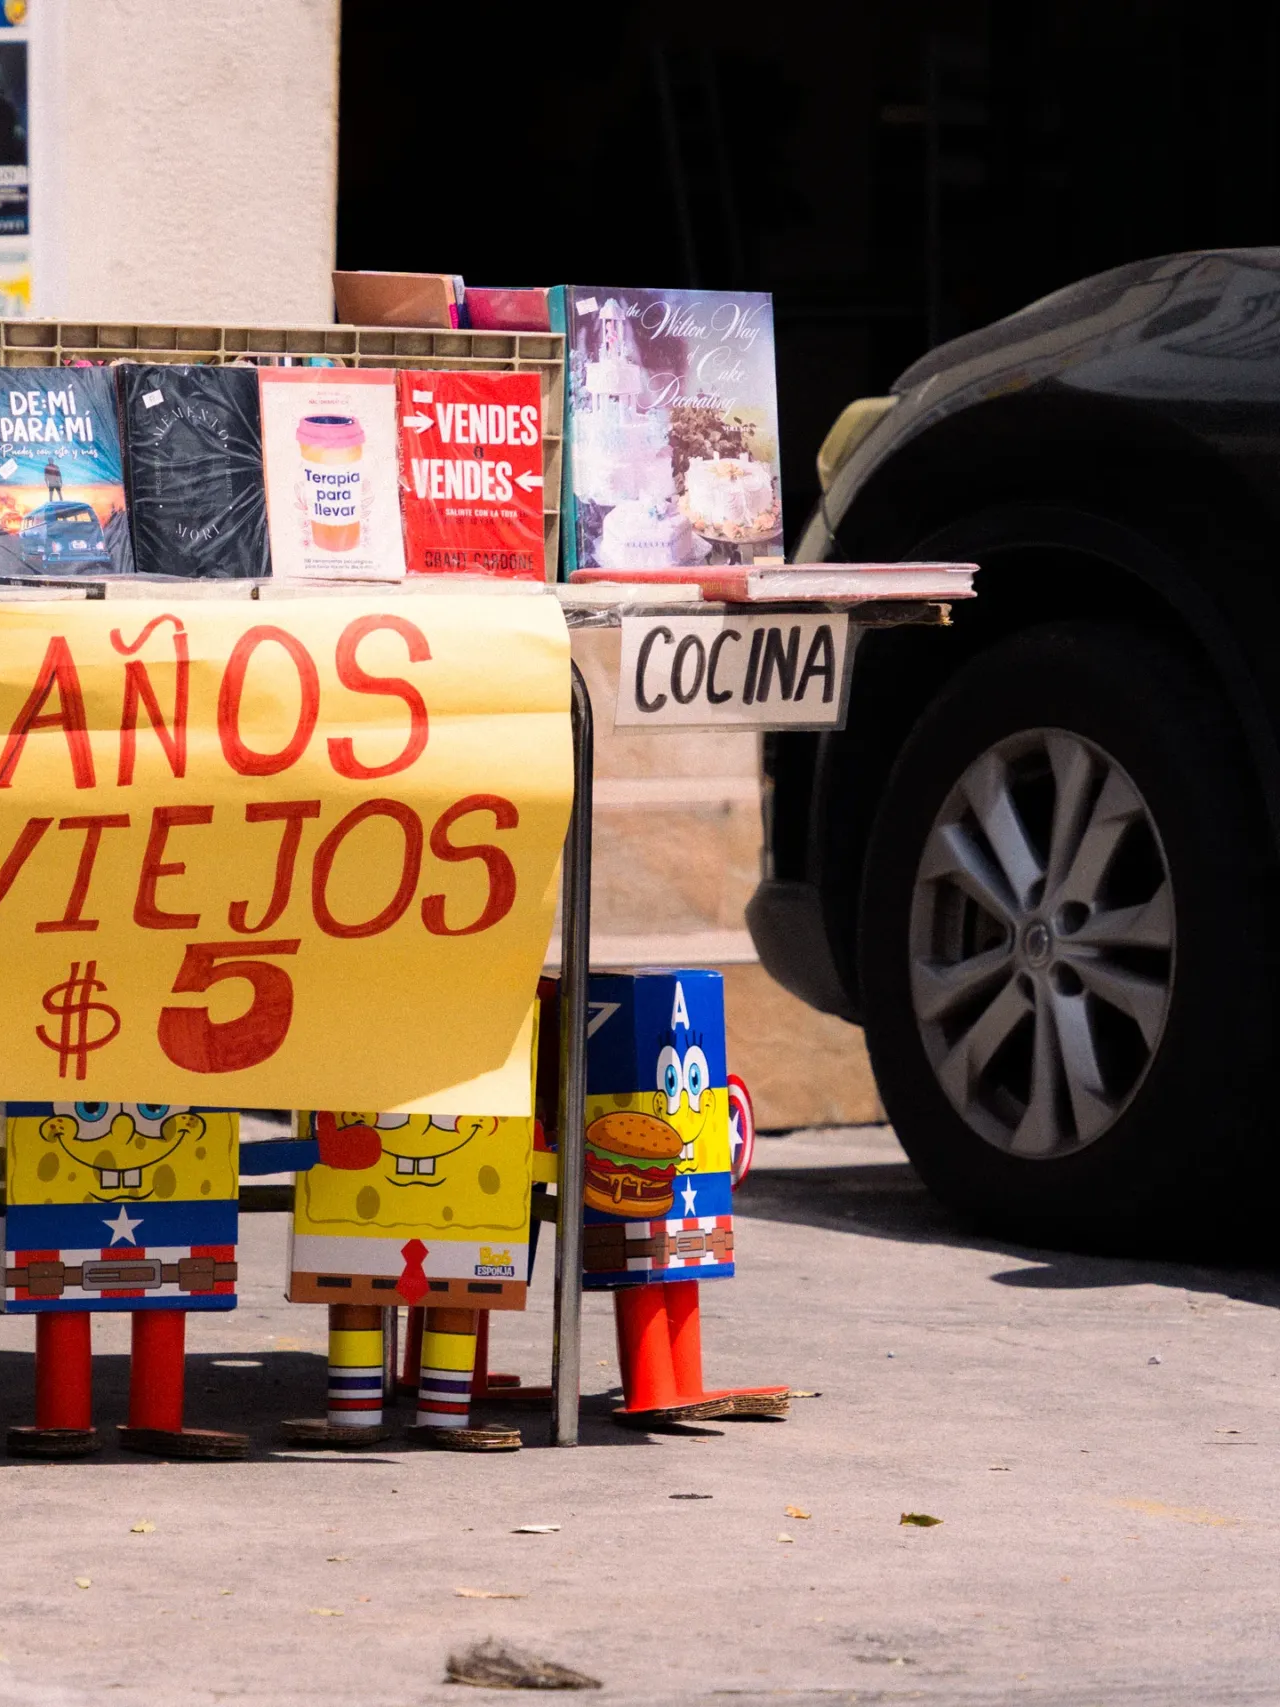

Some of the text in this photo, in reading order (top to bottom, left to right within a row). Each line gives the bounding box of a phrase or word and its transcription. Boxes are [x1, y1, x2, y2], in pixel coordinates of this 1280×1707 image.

[641, 301, 714, 340] Wilton
[710, 303, 771, 351] Way
[697, 346, 748, 384] Cake
[153, 406, 230, 440] MEMENTO
[435, 403, 538, 446] VENDES
[304, 468, 360, 487] Terapia
[411, 458, 513, 502] VENDES
[316, 489, 352, 502] para
[314, 503, 356, 517] llevar
[445, 508, 473, 517] SALIRTE
[475, 509, 489, 517] CON
[176, 523, 220, 542] MORI
[425, 552, 535, 571] GRANT CARDONE
[635, 625, 836, 713] COCINA
[477, 1266, 512, 1276] ESPONJA
